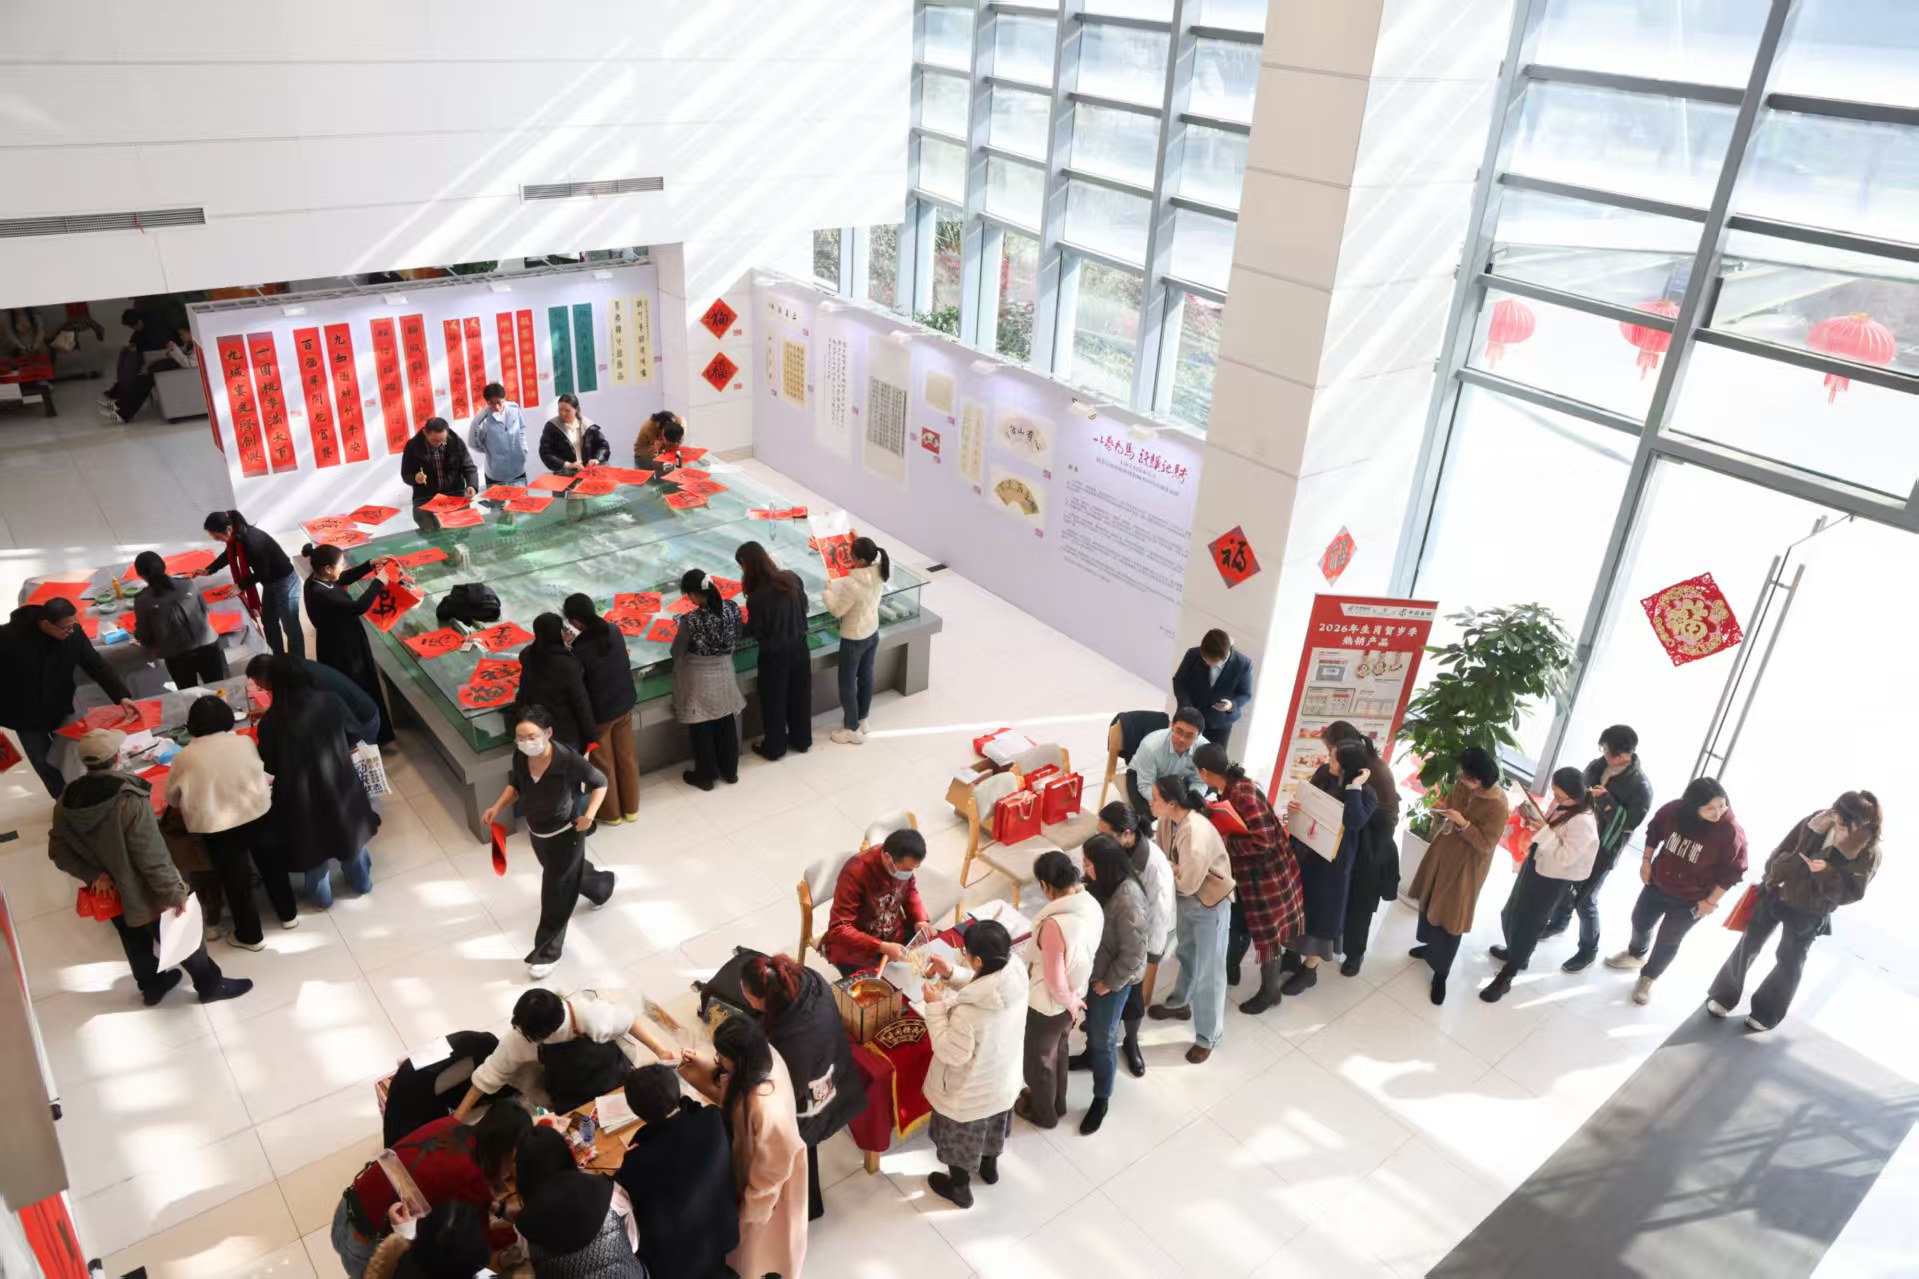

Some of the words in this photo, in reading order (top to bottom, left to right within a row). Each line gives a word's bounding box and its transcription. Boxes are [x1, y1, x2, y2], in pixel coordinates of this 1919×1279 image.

[1221, 538, 1247, 572] 福
[1319, 623, 1417, 637] 2026年生肖贺岁季
[1342, 636, 1389, 647] 热销产品
